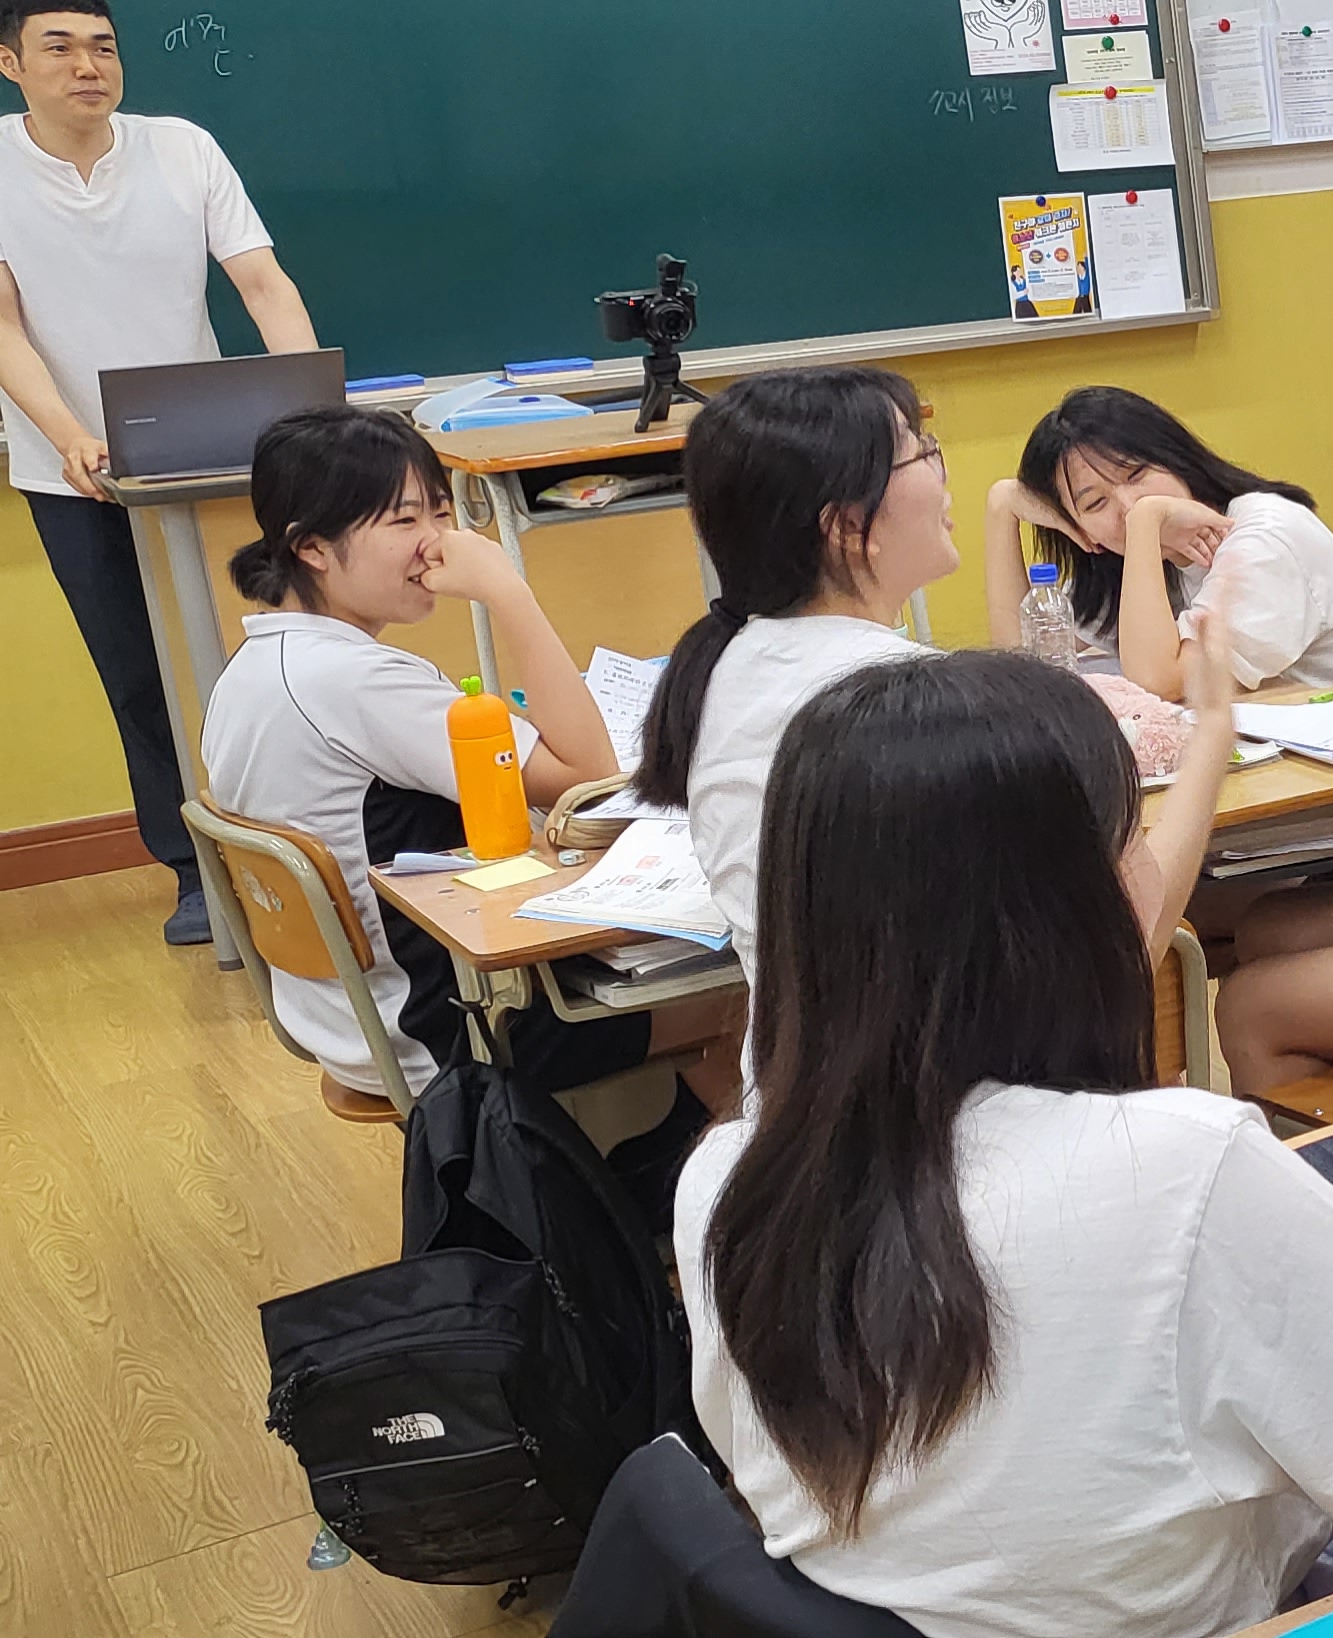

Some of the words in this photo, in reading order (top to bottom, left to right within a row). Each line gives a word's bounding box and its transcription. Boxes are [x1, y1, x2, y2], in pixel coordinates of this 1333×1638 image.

[386, 1414, 417, 1427] THE
[372, 1422, 419, 1437] NORTH
[387, 1431, 422, 1445] FACE
